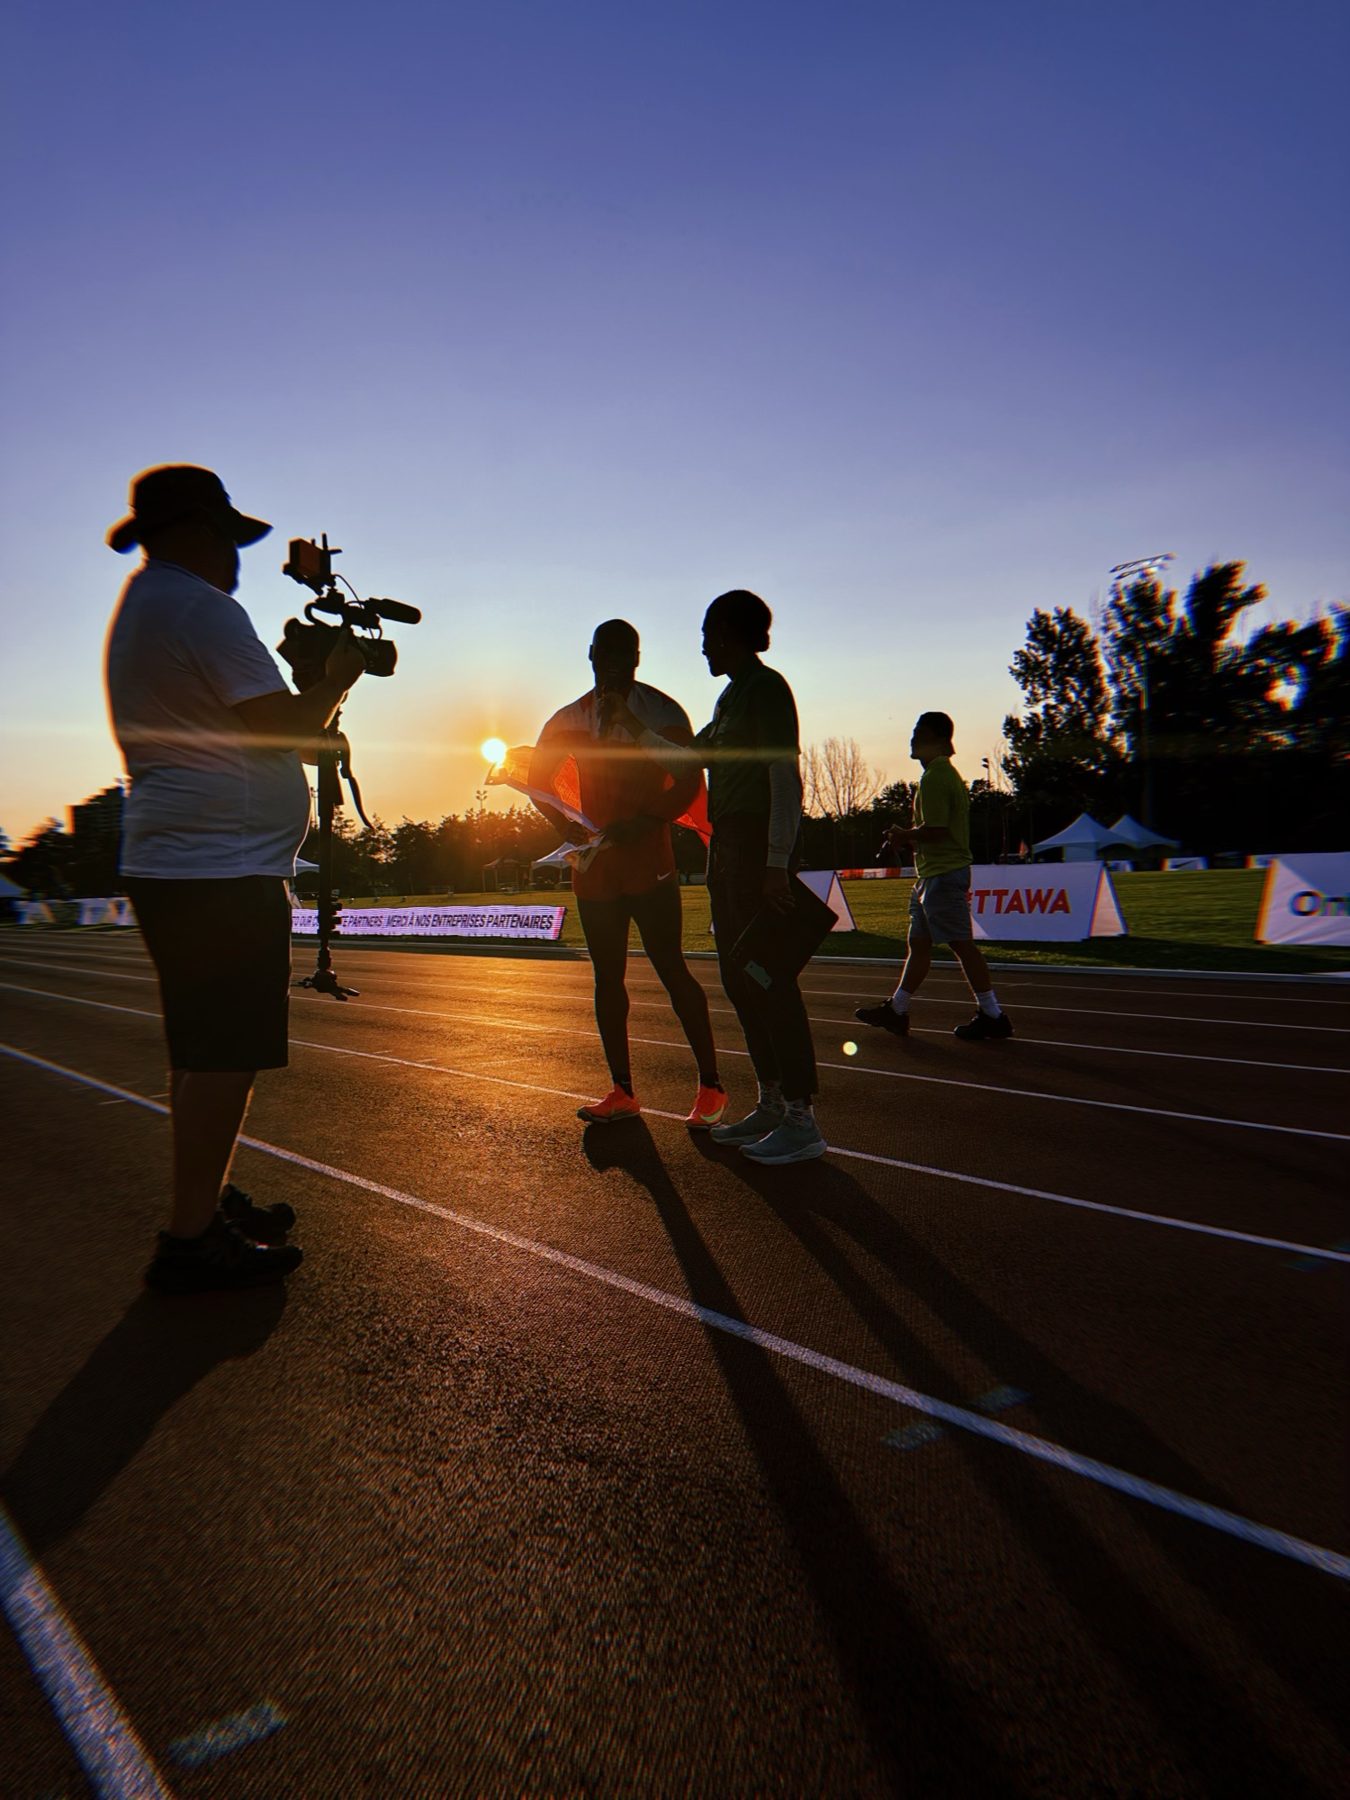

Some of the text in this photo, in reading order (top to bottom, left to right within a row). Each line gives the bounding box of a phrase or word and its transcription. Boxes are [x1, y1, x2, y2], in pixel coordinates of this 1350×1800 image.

[966, 888, 1071, 914] TTAWA
[348, 915, 383, 928] PARTNERS
[386, 914, 408, 927] MERCI
[415, 914, 431, 928] NOS
[431, 914, 487, 928] ENTREPRISES
[487, 914, 553, 929] PARTENAIRES
